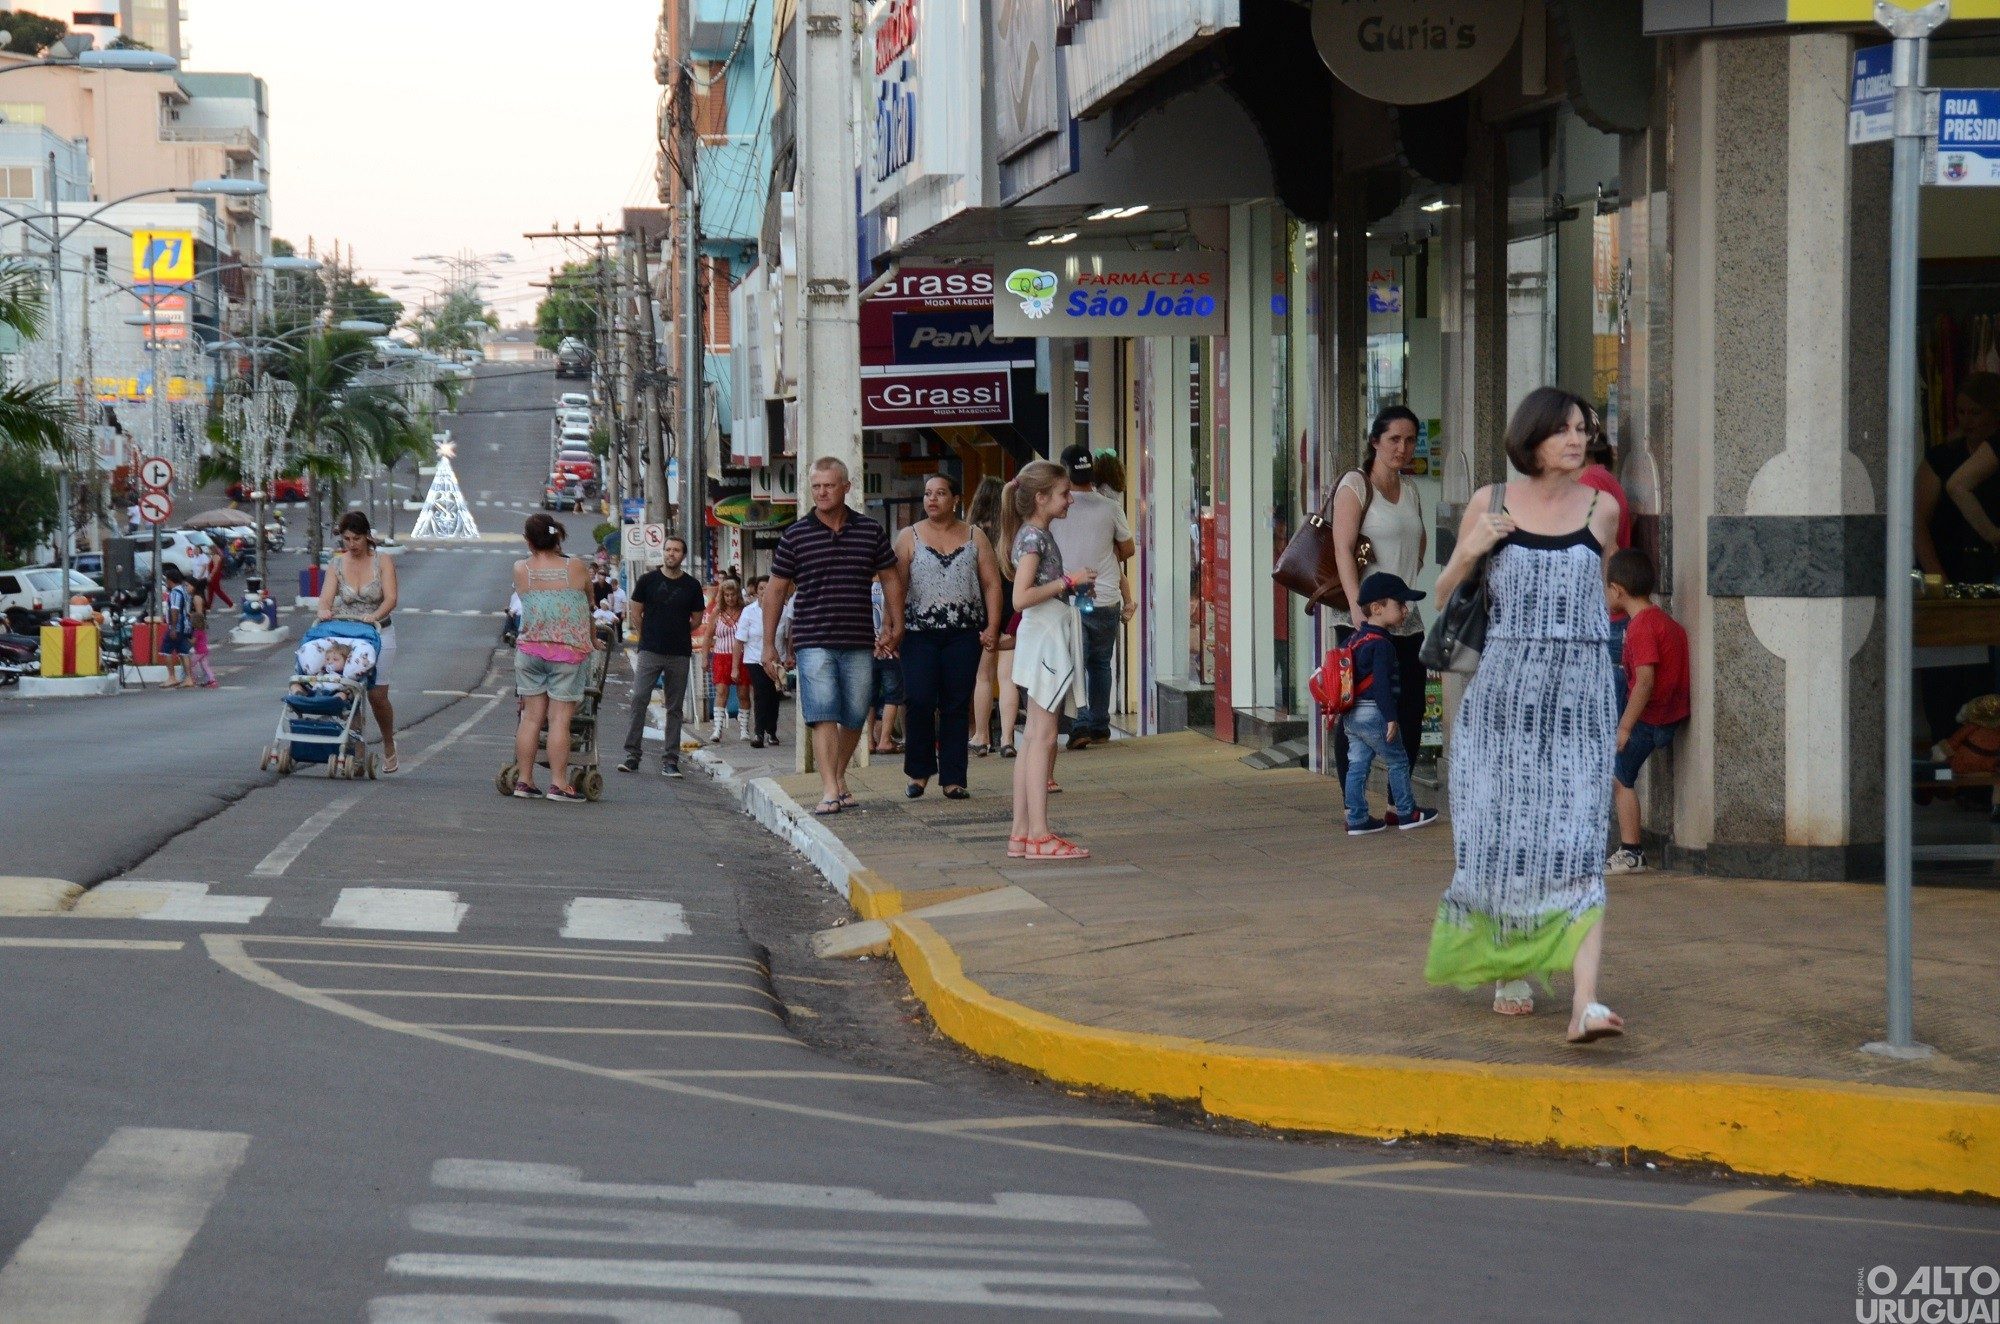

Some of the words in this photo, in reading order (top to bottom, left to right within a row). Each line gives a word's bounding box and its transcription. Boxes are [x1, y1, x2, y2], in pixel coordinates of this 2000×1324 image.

[1357, 15, 1476, 52] Guria's
[1945, 98, 1978, 115] RUA
[1944, 118, 2000, 141] PRESID
[873, 273, 993, 297] Grass
[1077, 269, 1211, 286] FARMÁCIAS
[1065, 289, 1129, 317] São
[1137, 289, 1216, 318] João
[883, 382, 1000, 406] Grassi
